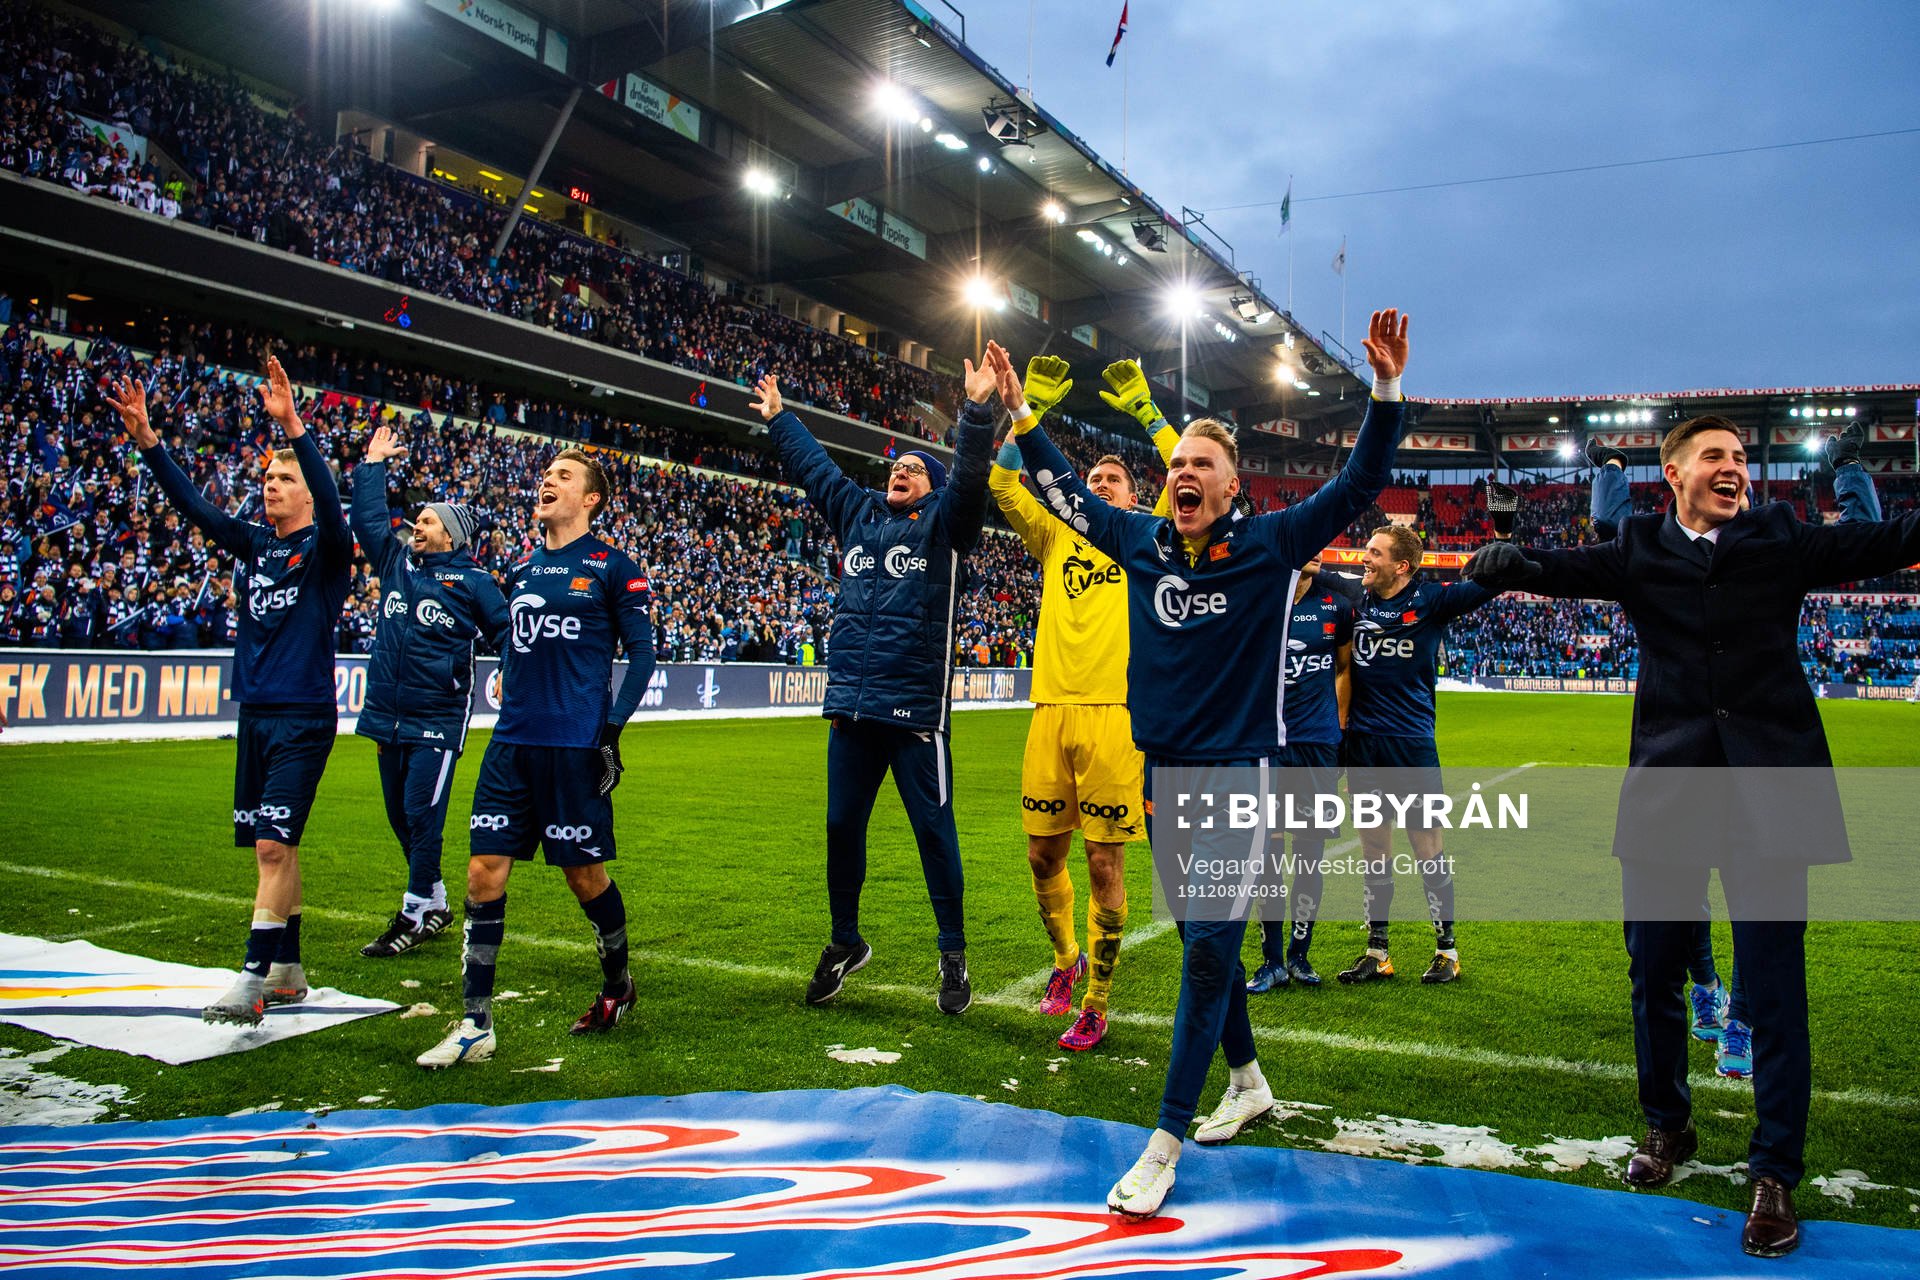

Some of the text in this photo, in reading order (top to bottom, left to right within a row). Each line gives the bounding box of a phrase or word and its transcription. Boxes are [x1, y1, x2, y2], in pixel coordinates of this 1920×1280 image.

[475, 7, 537, 48] Norsk Tippin
[571, 187, 589, 204] 15:11
[857, 207, 910, 250] Nors Tipping
[1261, 420, 1296, 435] VG
[1877, 426, 1914, 440] V
[1413, 435, 1469, 449] VG
[1597, 433, 1656, 446] VG
[543, 566, 569, 574] OBOS
[895, 555, 928, 574] Lyse
[1068, 563, 1121, 596] Lyse
[1165, 591, 1227, 621] Lyse
[425, 606, 455, 628] Lyse
[1293, 614, 1318, 622] OBOS
[518, 611, 581, 645] Lyse
[1359, 632, 1415, 660] Lyse
[65, 664, 146, 718] MED
[158, 665, 231, 716] NM-
[335, 666, 367, 713] 20
[769, 672, 782, 704] VI
[784, 671, 829, 704] GRATU
[994, 674, 1015, 698] 2019
[1504, 679, 1512, 690] VI
[1513, 679, 1560, 690] GRATULERER
[1562, 680, 1593, 691] VIKING
[1594, 680, 1606, 691] FK
[1608, 680, 1625, 691] MED
[1857, 686, 1915, 698] VI GRATULERE
[893, 709, 911, 718] KH
[423, 731, 445, 740] BLA
[1022, 795, 1066, 816] coop
[1080, 801, 1128, 821] coop
